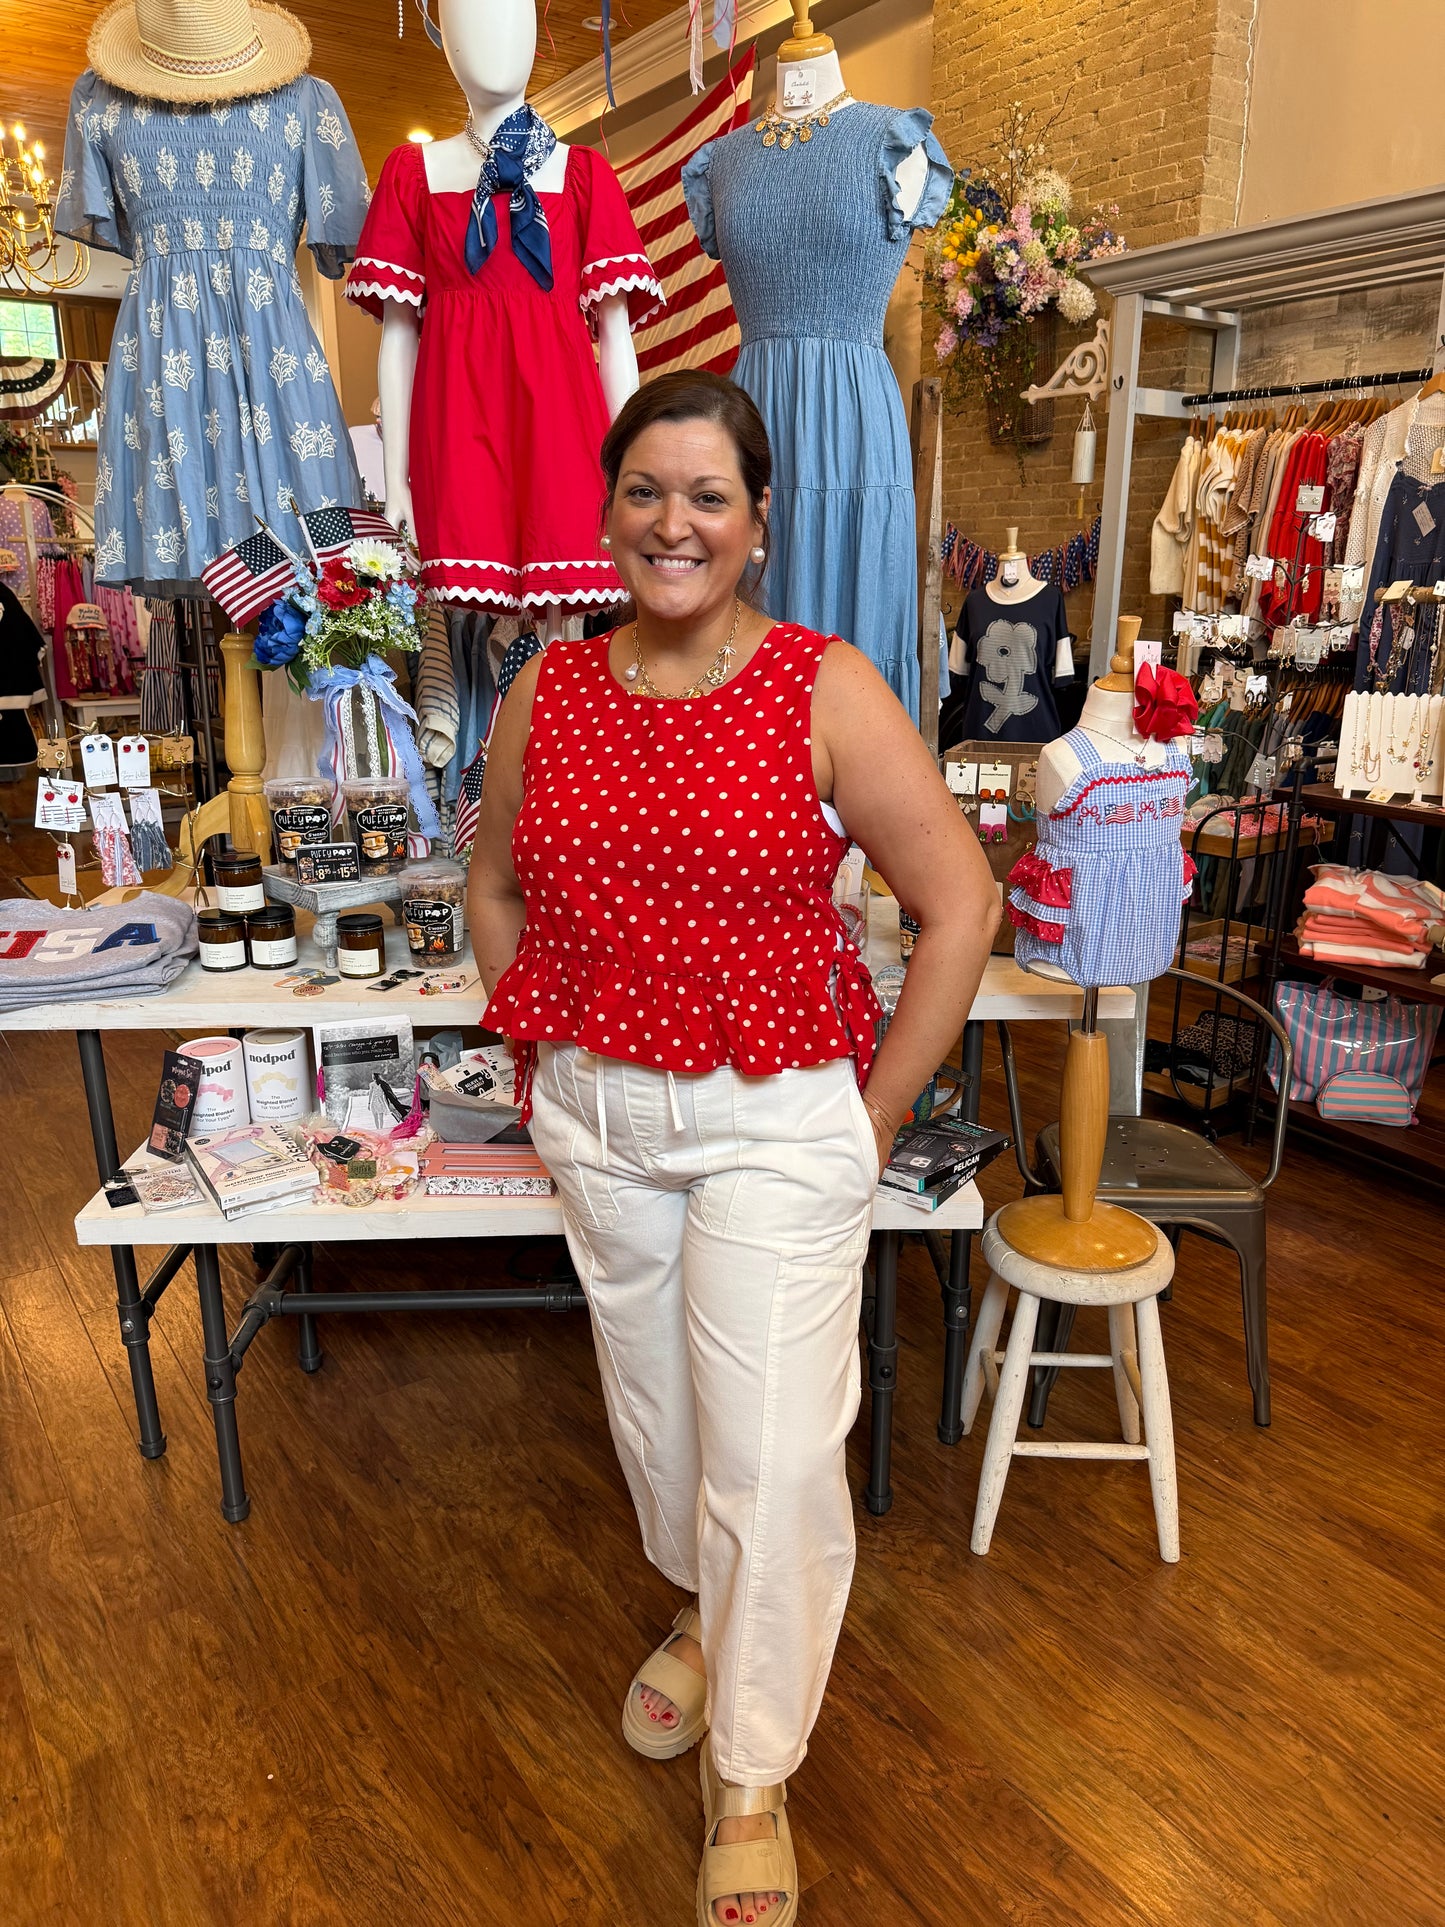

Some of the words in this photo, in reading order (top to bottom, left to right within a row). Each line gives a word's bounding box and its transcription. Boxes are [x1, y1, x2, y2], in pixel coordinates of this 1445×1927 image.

[0, 922, 162, 964] USA
[249, 1048, 296, 1066] nodpod
[953, 1153, 980, 1174] PELICAN
[957, 1166, 978, 1189] PELICAN
